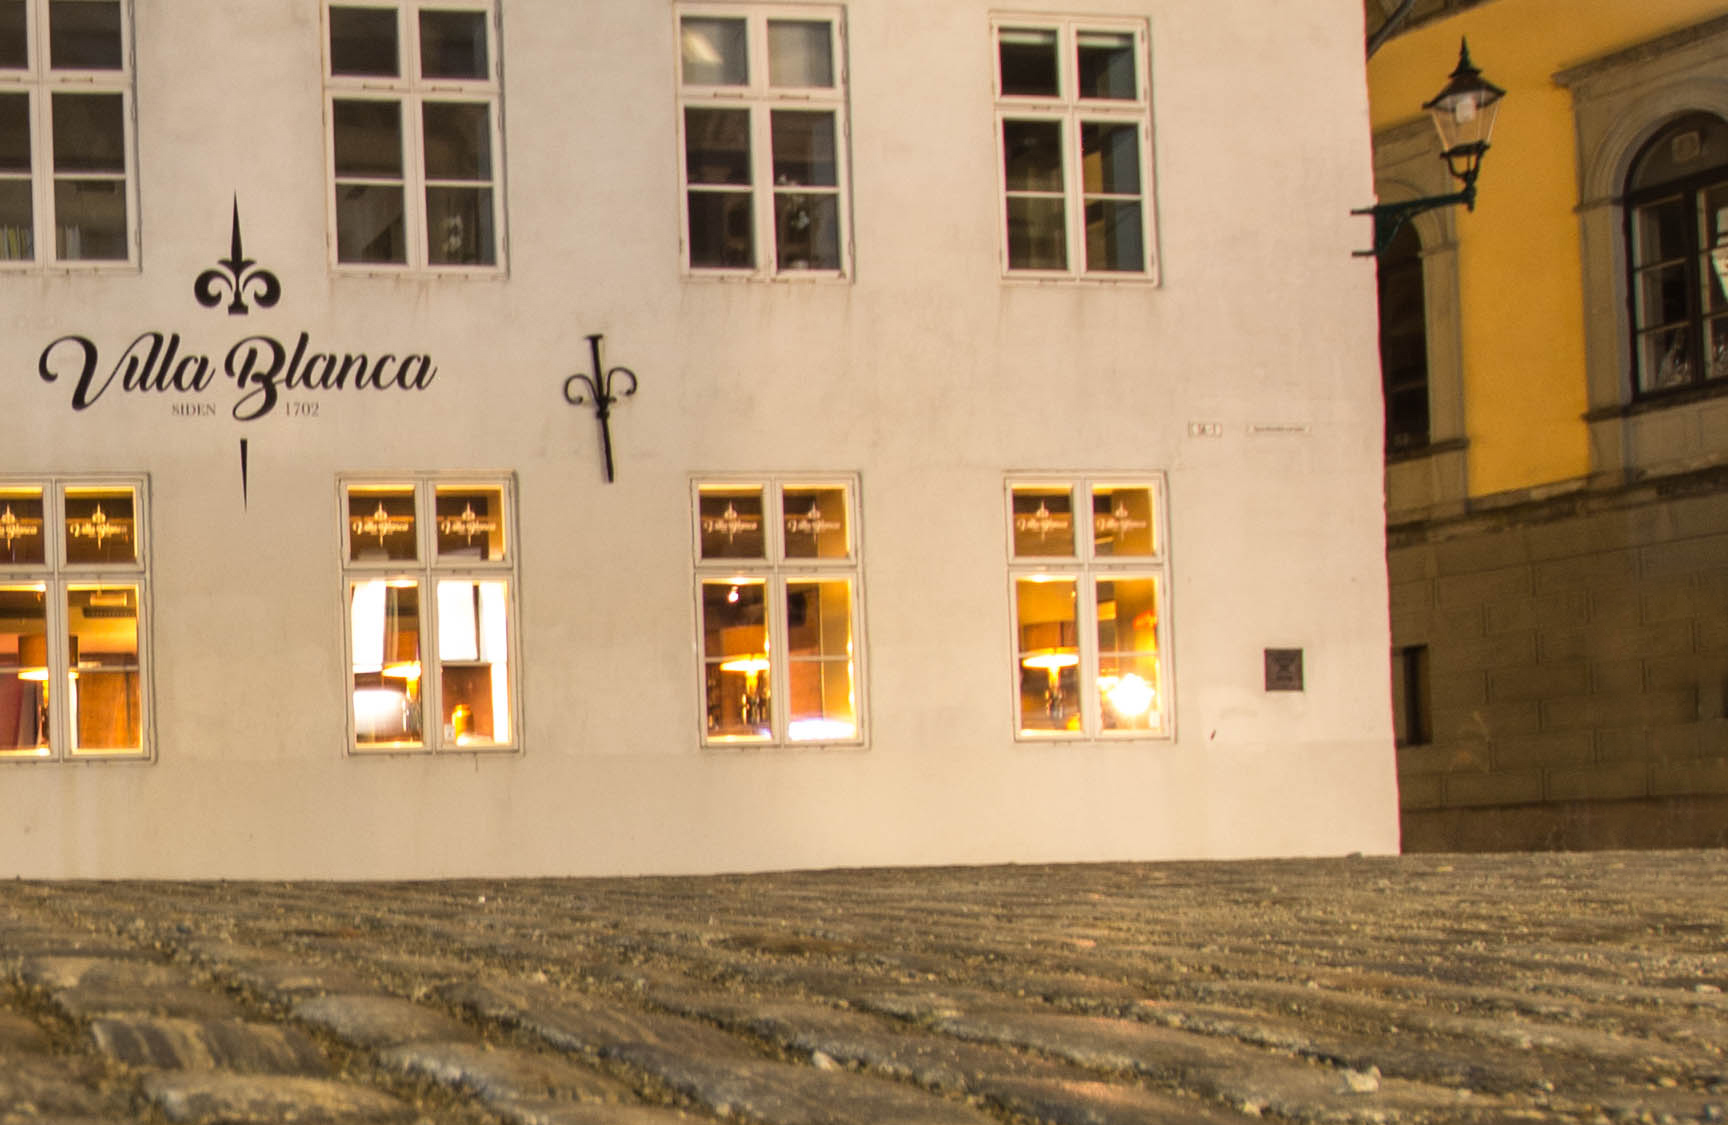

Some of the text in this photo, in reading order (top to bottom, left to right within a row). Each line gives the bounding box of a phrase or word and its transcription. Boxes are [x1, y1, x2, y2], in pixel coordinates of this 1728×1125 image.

[38, 332, 438, 422] Villa Blanca
[172, 402, 320, 417] SIDEN 1702
